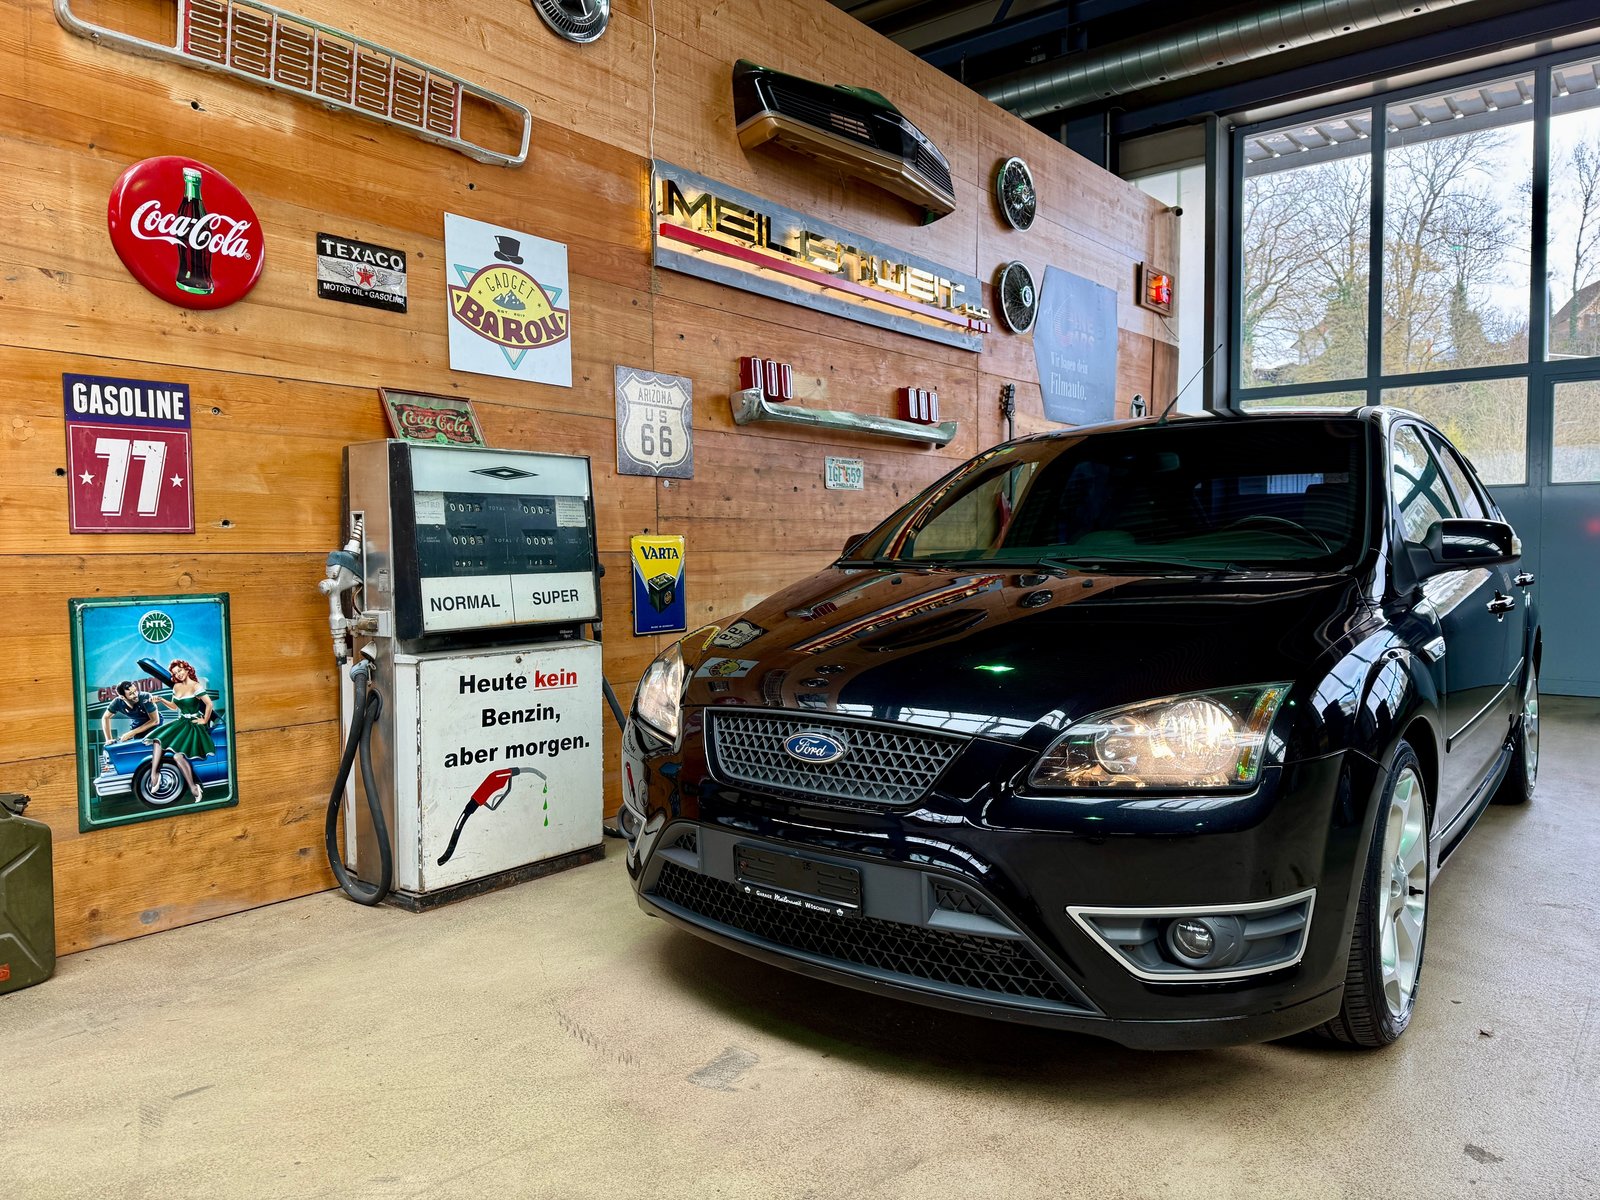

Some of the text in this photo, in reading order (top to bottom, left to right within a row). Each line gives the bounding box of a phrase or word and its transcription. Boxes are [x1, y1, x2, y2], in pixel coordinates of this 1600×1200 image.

[130, 200, 252, 259] Coca-Cola
[321, 239, 404, 272] TEXACO
[323, 282, 351, 294] MOTOR
[352, 288, 365, 297] OIL
[485, 272, 536, 299] GADGET
[457, 294, 565, 344] BARON
[72, 382, 185, 420] GASOLINE
[638, 387, 673, 405] ARIZONA
[641, 423, 673, 457] 66
[94, 437, 167, 517] 77
[640, 545, 680, 560] VARTA
[430, 589, 579, 612] NORMAL SUPER
[459, 668, 578, 694] Heute kein
[482, 703, 561, 728] Benzin,
[444, 735, 590, 768] aber morgen.
[795, 738, 826, 758] Ford
